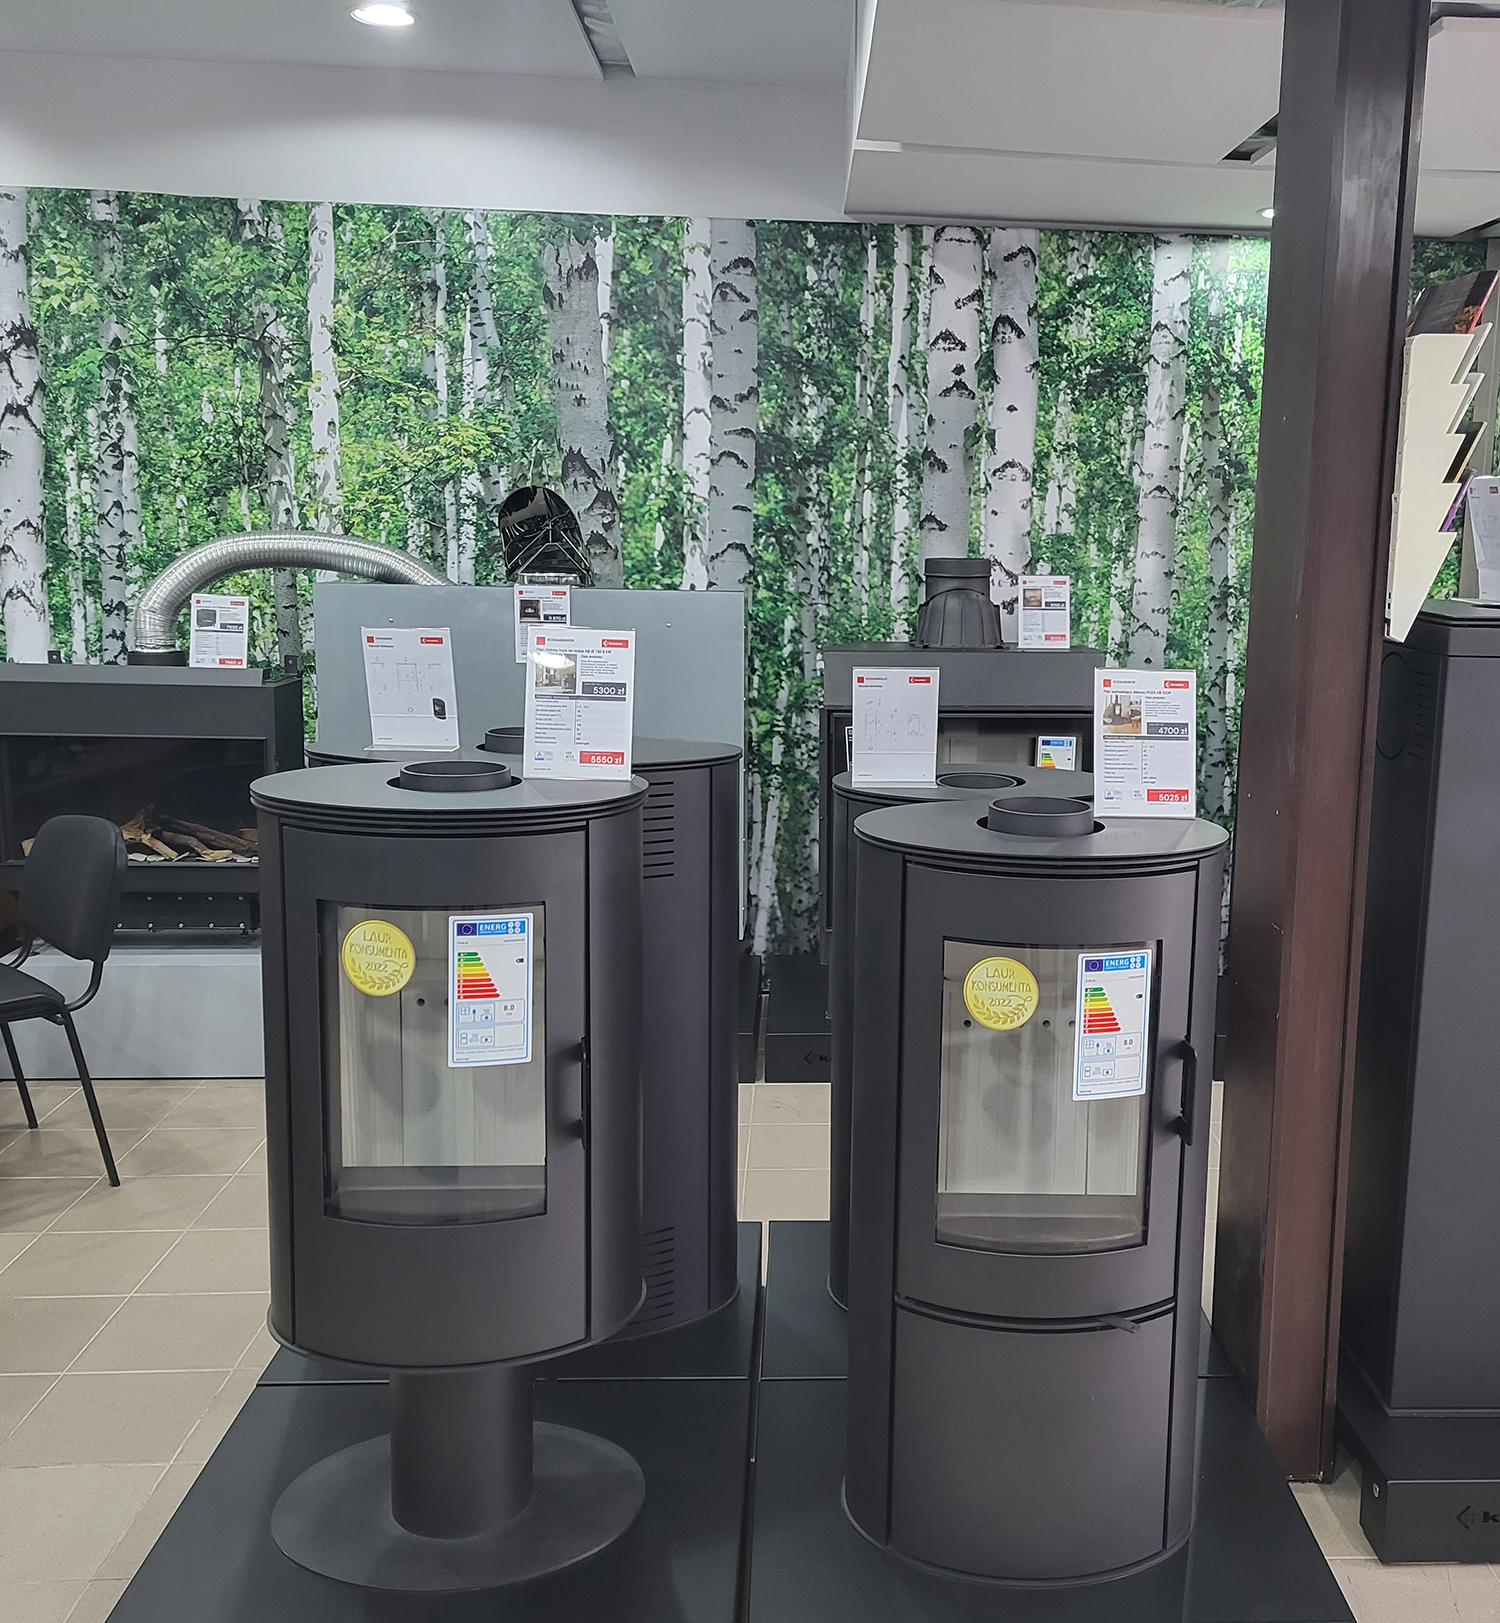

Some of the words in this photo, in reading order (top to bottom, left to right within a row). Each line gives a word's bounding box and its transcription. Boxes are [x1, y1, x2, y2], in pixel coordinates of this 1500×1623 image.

[615, 756, 622, 764] zł
[480, 923, 506, 931] ENERG
[363, 930, 392, 944] LAUR
[349, 942, 408, 959] KONSUMENTA
[365, 962, 388, 972] 2022
[1106, 959, 1129, 967] ENERG
[986, 967, 1015, 979] LAUR
[971, 980, 1032, 993] KONSUMENTA
[988, 997, 1012, 1007] 2022
